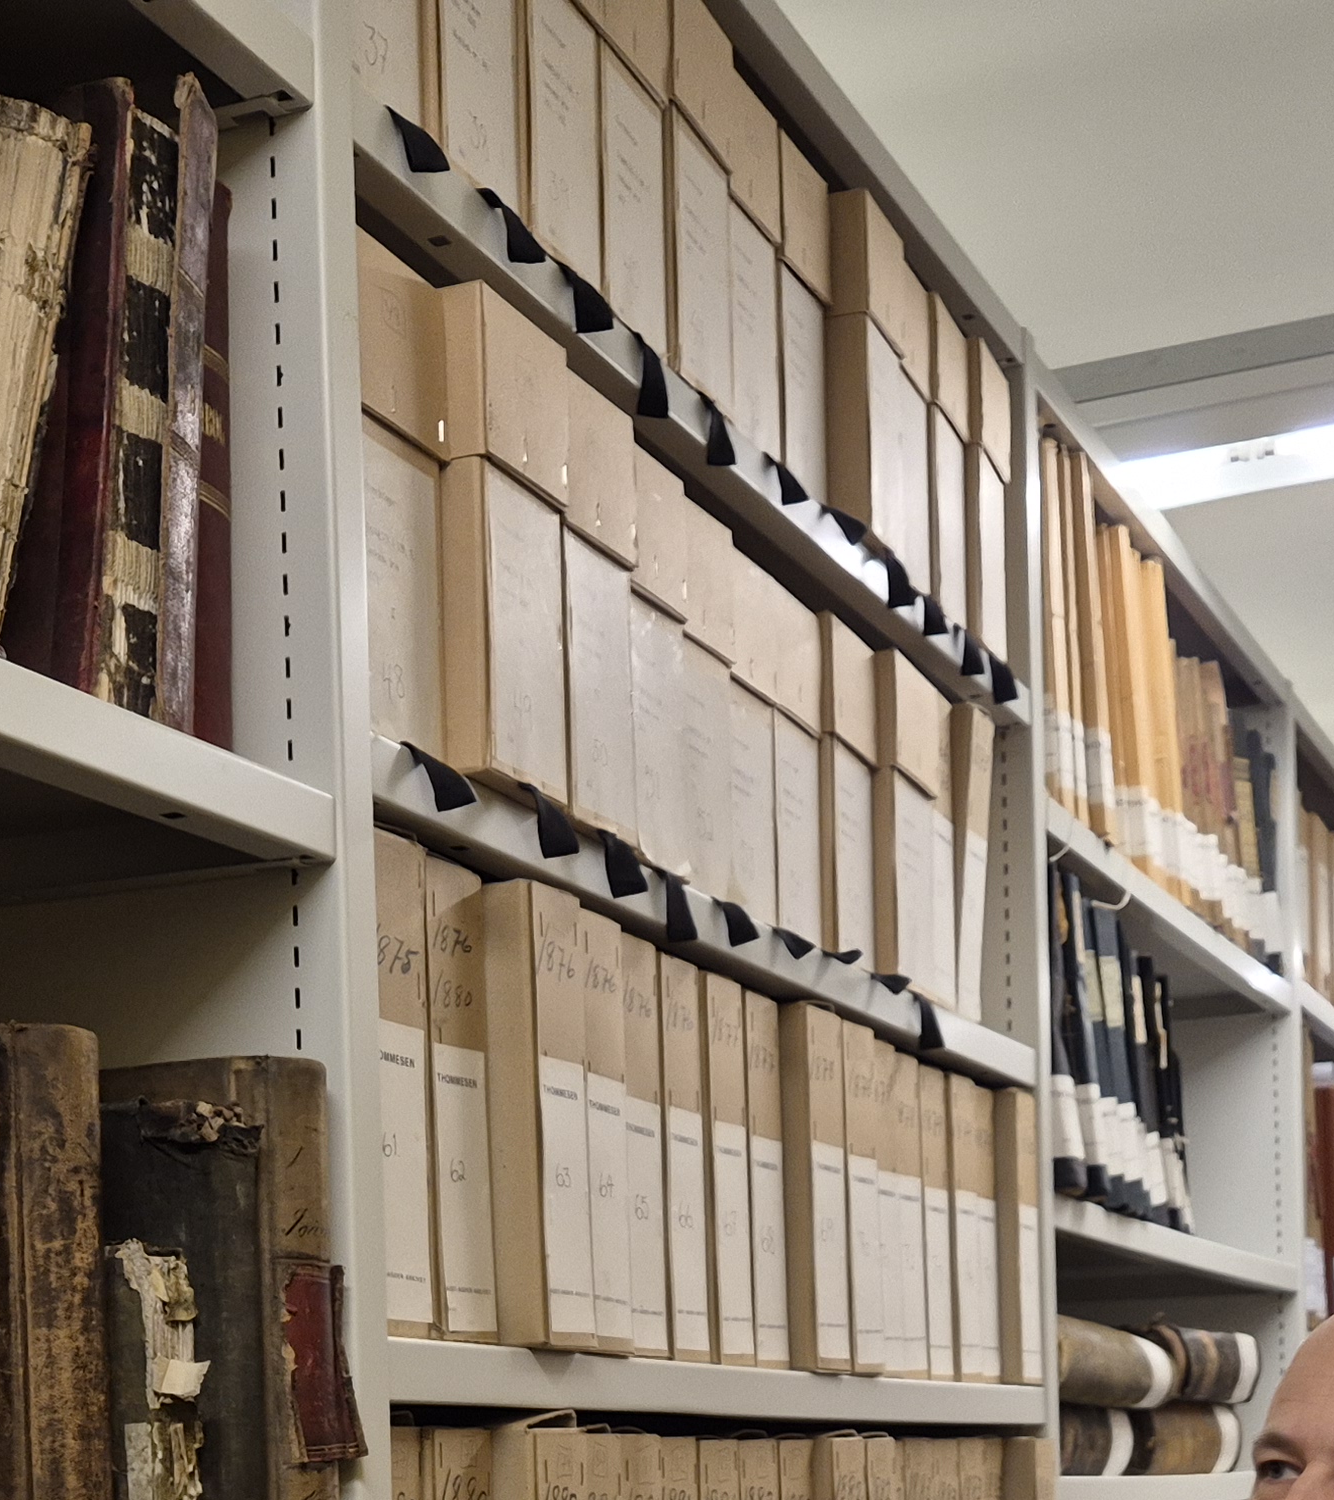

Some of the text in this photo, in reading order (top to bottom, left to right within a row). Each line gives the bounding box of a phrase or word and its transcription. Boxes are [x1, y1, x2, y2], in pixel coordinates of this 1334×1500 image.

[376, 924, 419, 975] 875
[433, 968, 474, 1010] 1880
[436, 1071, 478, 1090] THOMMESEN
[542, 1083, 579, 1101] THOMMESEN
[450, 1159, 466, 1183] 62
[555, 1165, 572, 1188] 63
